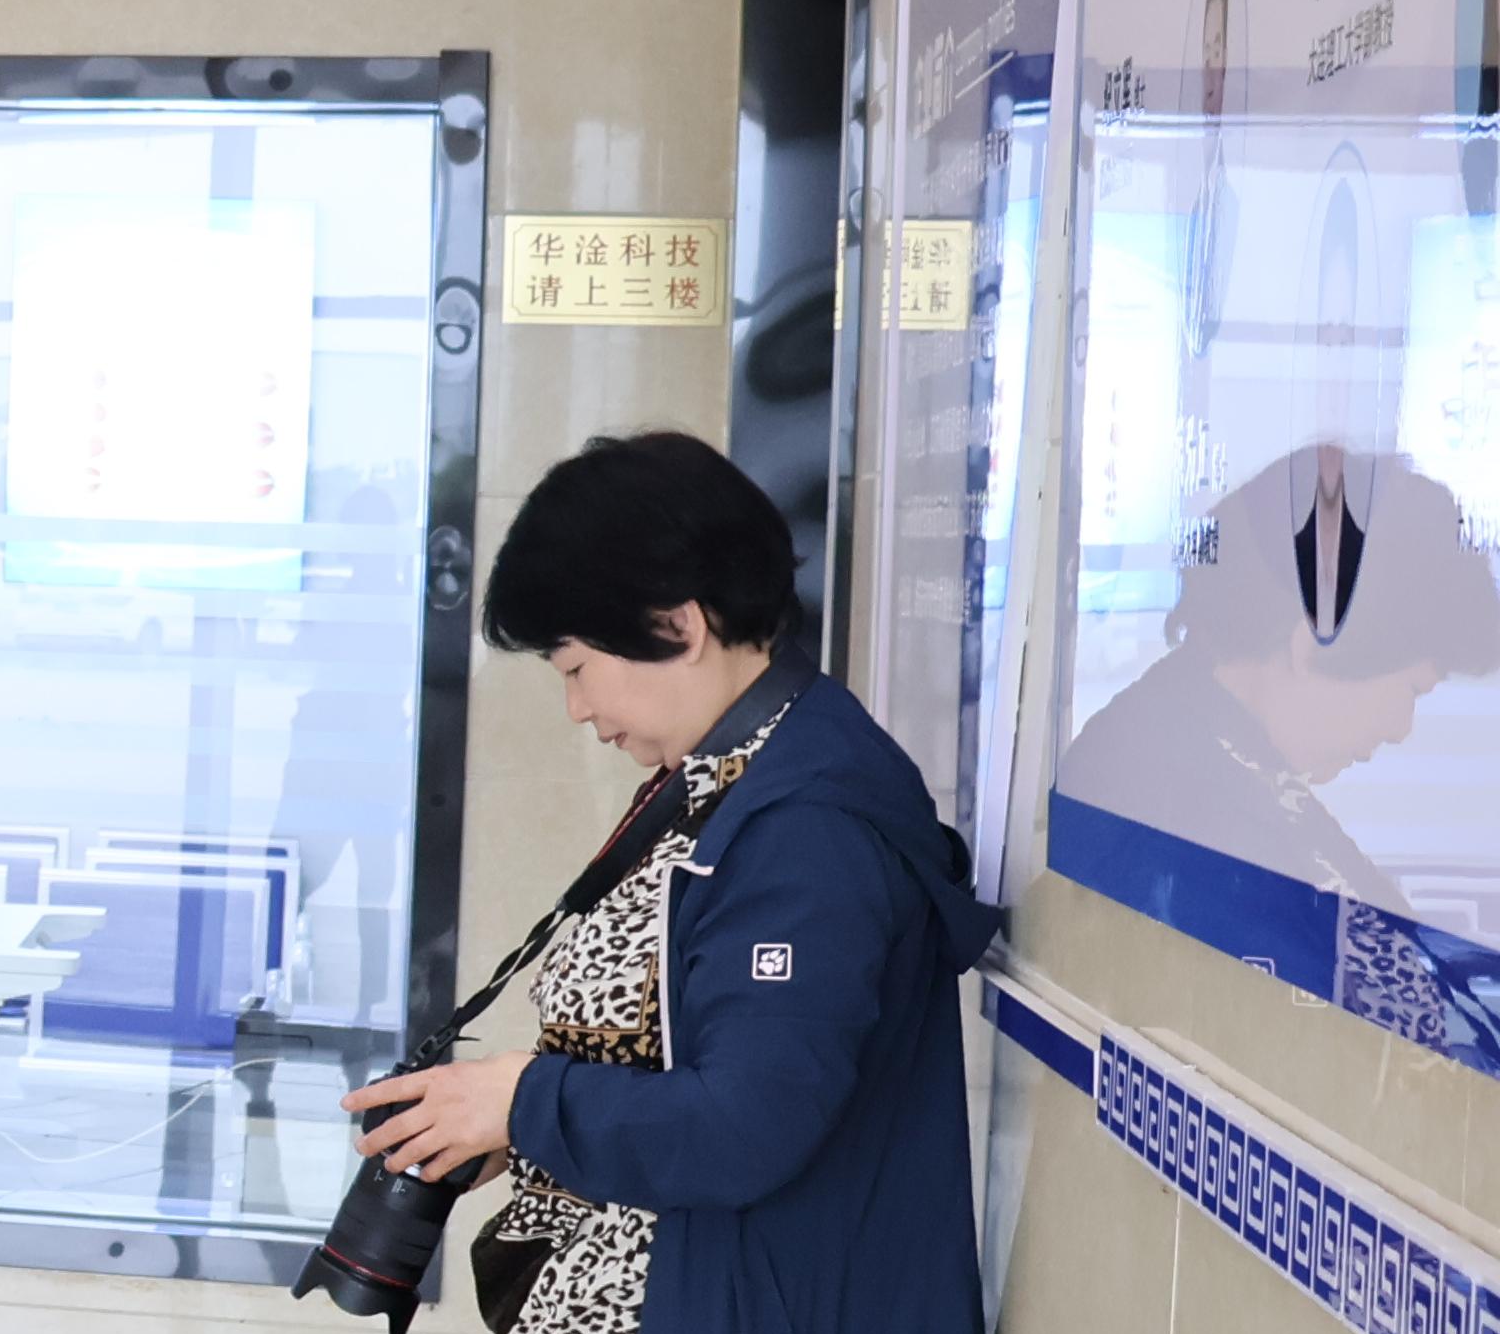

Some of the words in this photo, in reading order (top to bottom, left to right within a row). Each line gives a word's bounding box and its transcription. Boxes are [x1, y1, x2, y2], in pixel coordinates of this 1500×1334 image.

[528, 232, 700, 267] 华淦科技
[527, 275, 700, 310] 请上三楼
